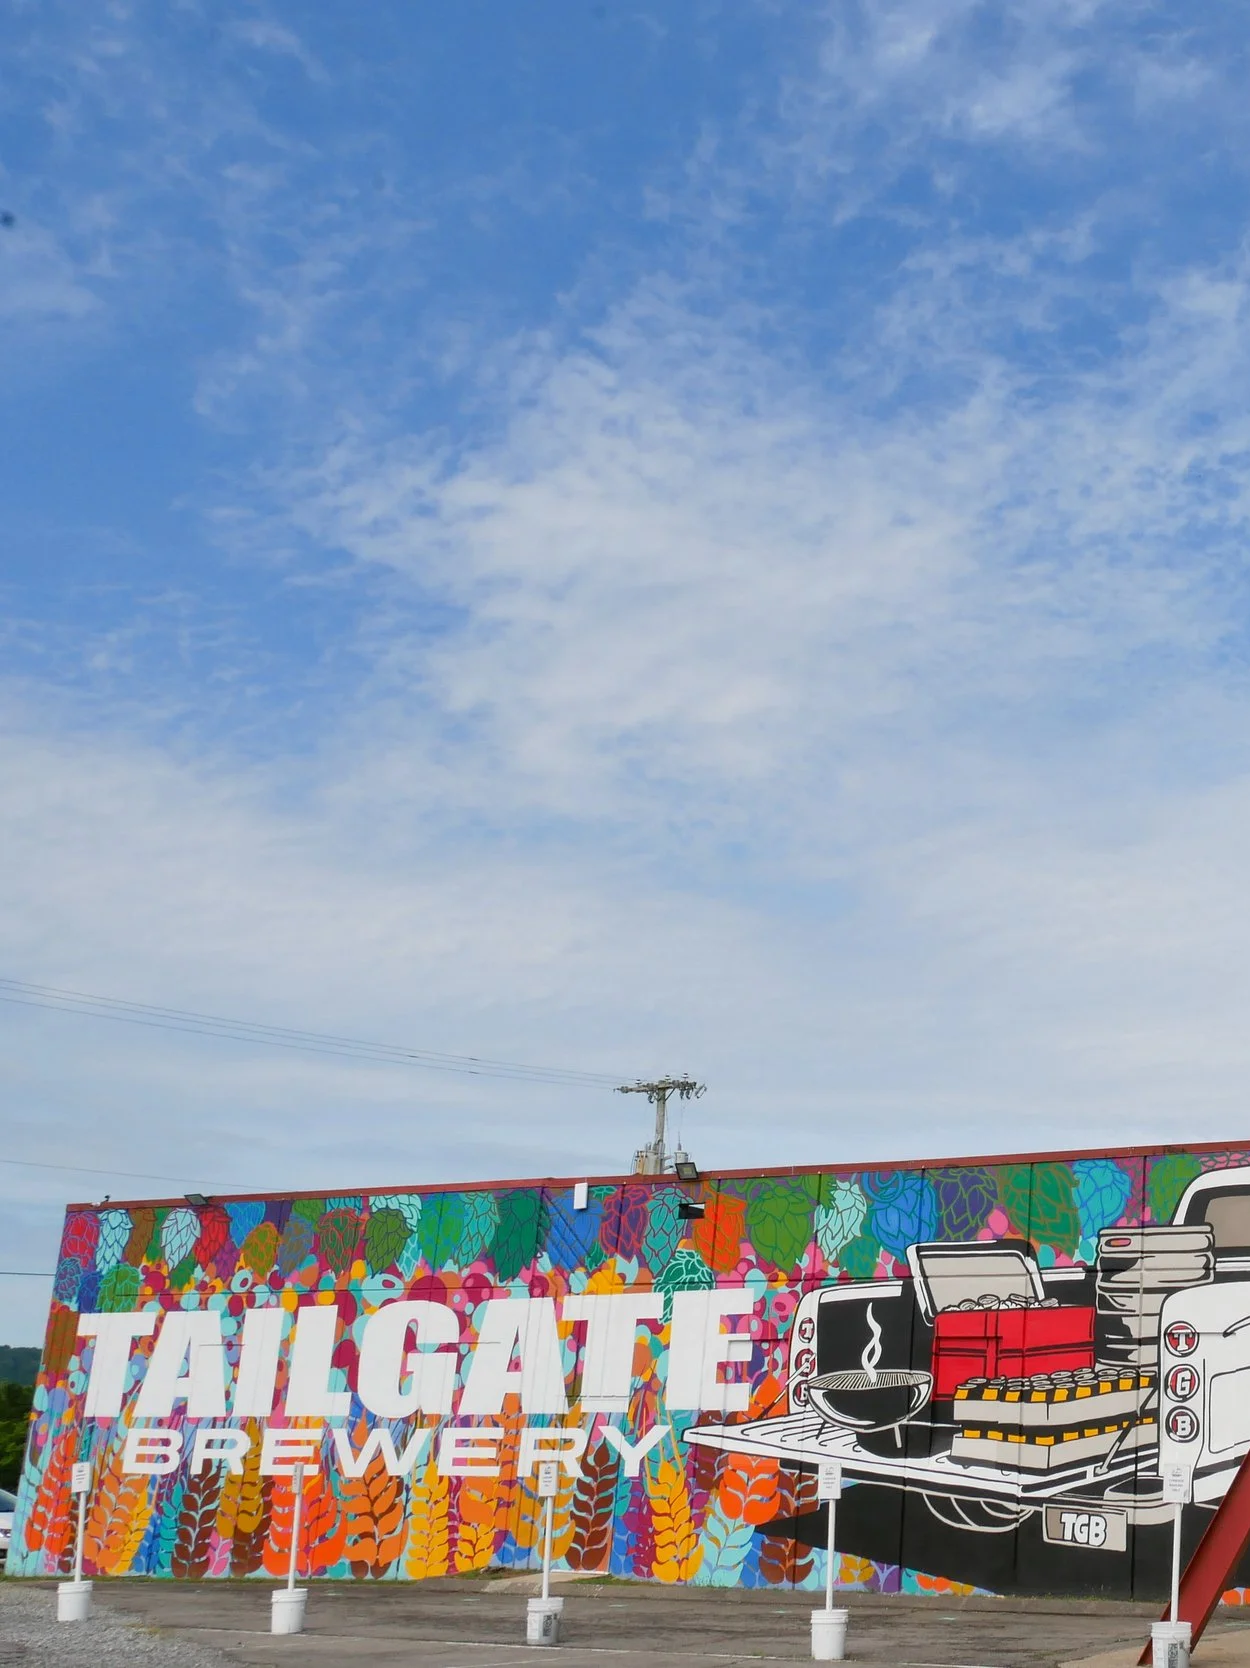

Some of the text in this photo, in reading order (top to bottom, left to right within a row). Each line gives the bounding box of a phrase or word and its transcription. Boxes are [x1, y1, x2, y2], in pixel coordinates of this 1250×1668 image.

[76, 1288, 755, 1419] TAILGATE
[121, 1425, 672, 1478] BREWERY
[1060, 1512, 1107, 1547] TGB
